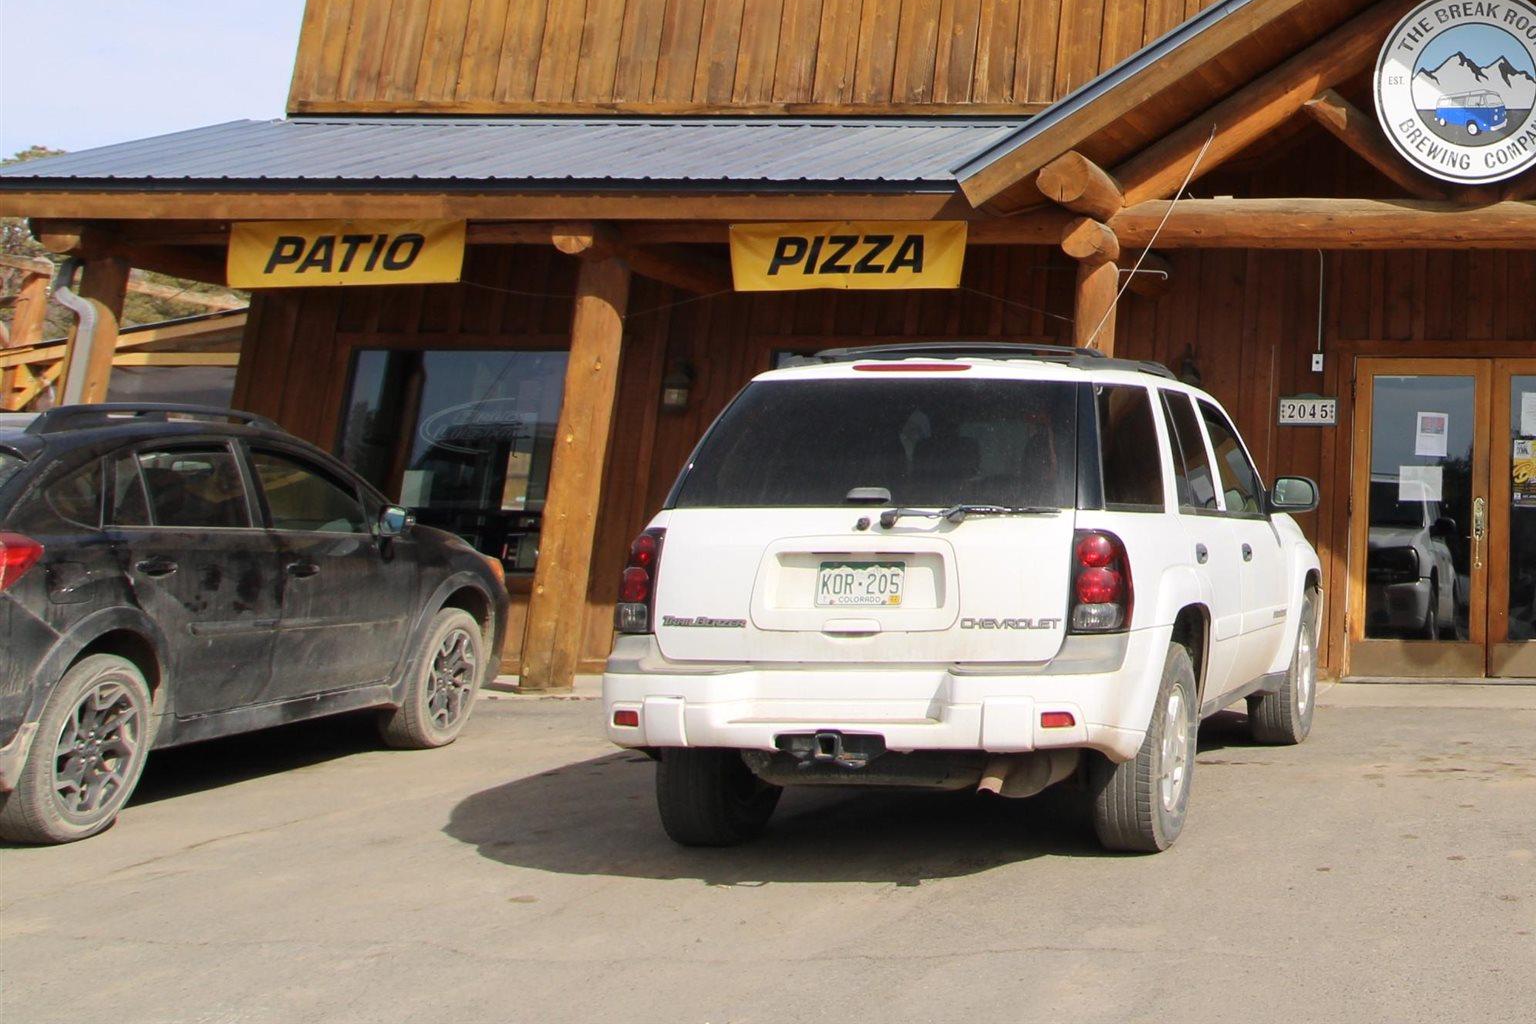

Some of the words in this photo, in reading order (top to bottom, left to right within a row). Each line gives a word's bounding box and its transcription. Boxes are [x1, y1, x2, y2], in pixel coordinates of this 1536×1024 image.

[1398, 17, 1435, 52] THE
[1434, 1, 1501, 24] BREAK
[1398, 118, 1471, 171] BREWING
[263, 233, 426, 274] PATIO
[767, 234, 925, 276] PIZZA
[1287, 403, 1329, 419] 2045
[838, 596, 881, 604] COLORADO
[960, 617, 1062, 630] CHEVROLET
